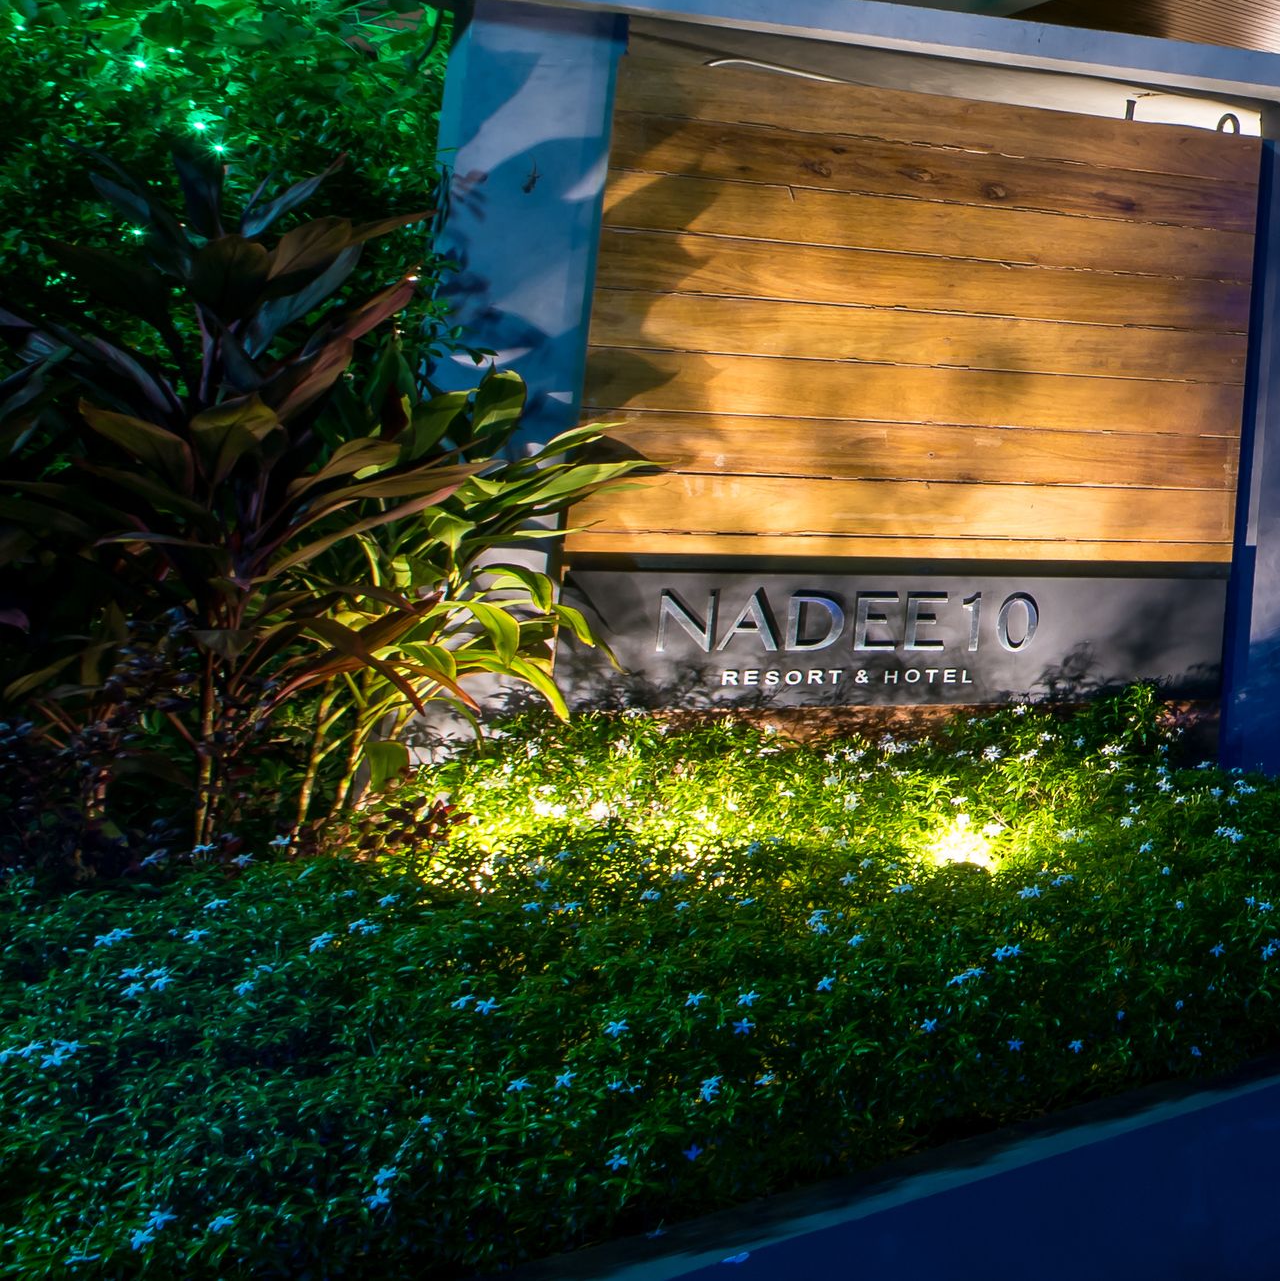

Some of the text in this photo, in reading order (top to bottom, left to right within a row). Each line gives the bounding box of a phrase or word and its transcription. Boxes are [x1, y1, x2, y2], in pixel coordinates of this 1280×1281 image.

[720, 669, 974, 686] RESORT & HOTEL
